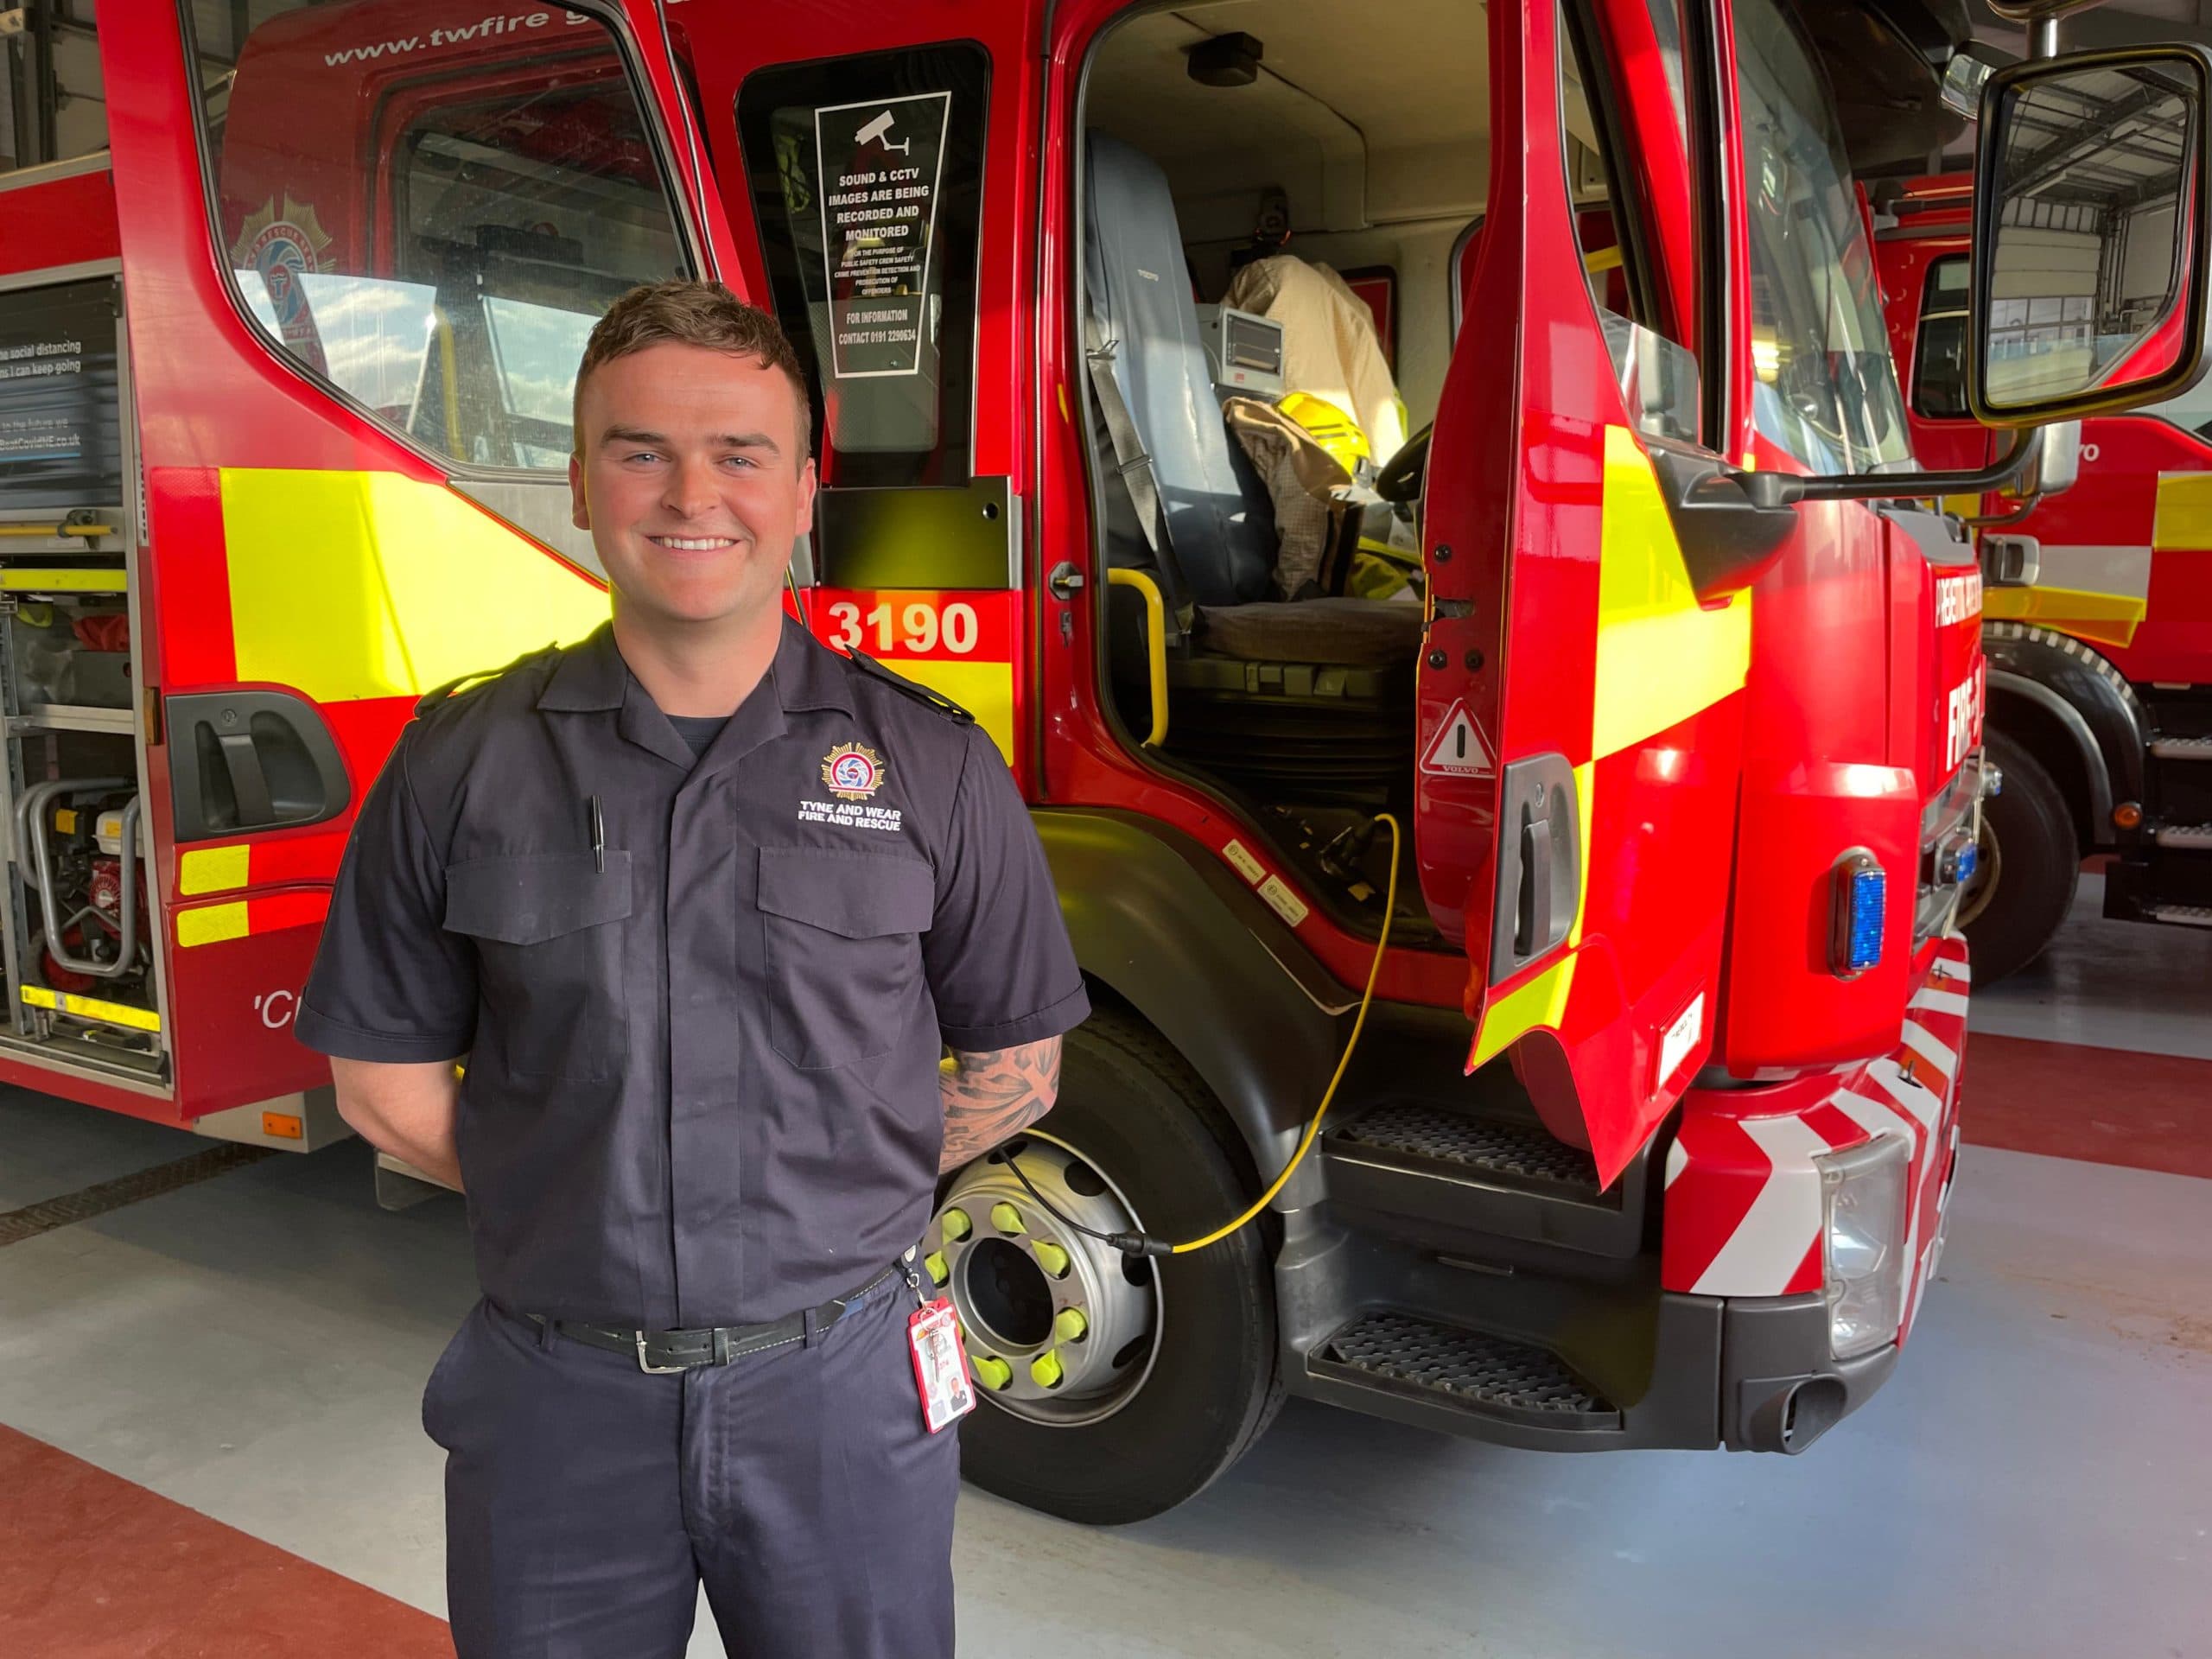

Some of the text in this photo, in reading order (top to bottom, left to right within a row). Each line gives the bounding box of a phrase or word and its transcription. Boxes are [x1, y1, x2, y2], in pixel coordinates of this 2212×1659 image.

[839, 168, 919, 187] SOUND & CCTV
[829, 185, 929, 207] IMAGES ARE BEING
[836, 206, 919, 224] RECORDED AND
[845, 225, 909, 241] MONITORED
[860, 257, 878, 266] SAFETY
[894, 255, 914, 264] SAFETY
[881, 265, 908, 275] DETECTION
[847, 308, 908, 324] FOR INFORMATION
[838, 331, 870, 345] CONTACT
[870, 330, 887, 343] 0191
[10, 344, 35, 359] social
[36, 340, 81, 356] distancing
[16, 365, 30, 377] can
[33, 363, 54, 376] keep
[54, 359, 81, 374] going
[828, 601, 978, 654] 3190
[1442, 766, 1478, 774] VOLVO
[800, 800, 901, 822] TYNE AND WEAR
[798, 810, 901, 832] FIRE AND RESCUE
